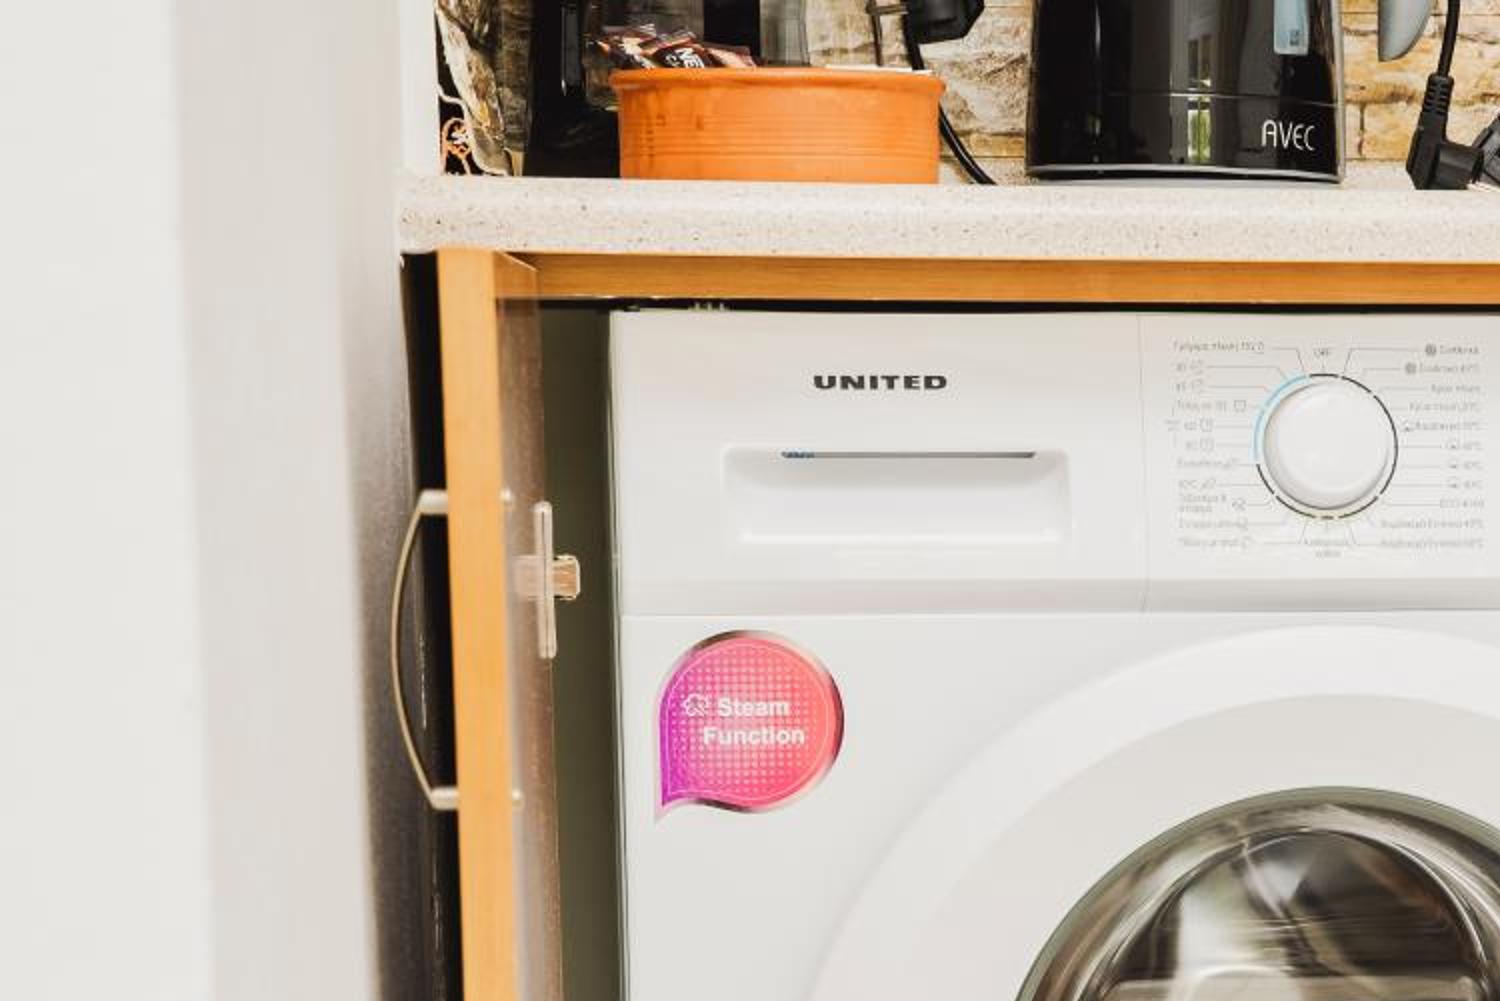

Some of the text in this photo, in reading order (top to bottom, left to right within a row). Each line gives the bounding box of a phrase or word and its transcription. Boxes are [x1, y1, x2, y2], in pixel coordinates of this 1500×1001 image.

[1261, 119, 1316, 151] AVEC
[813, 375, 948, 390] UNITED
[717, 697, 790, 717] Steam
[703, 726, 806, 745] Function
